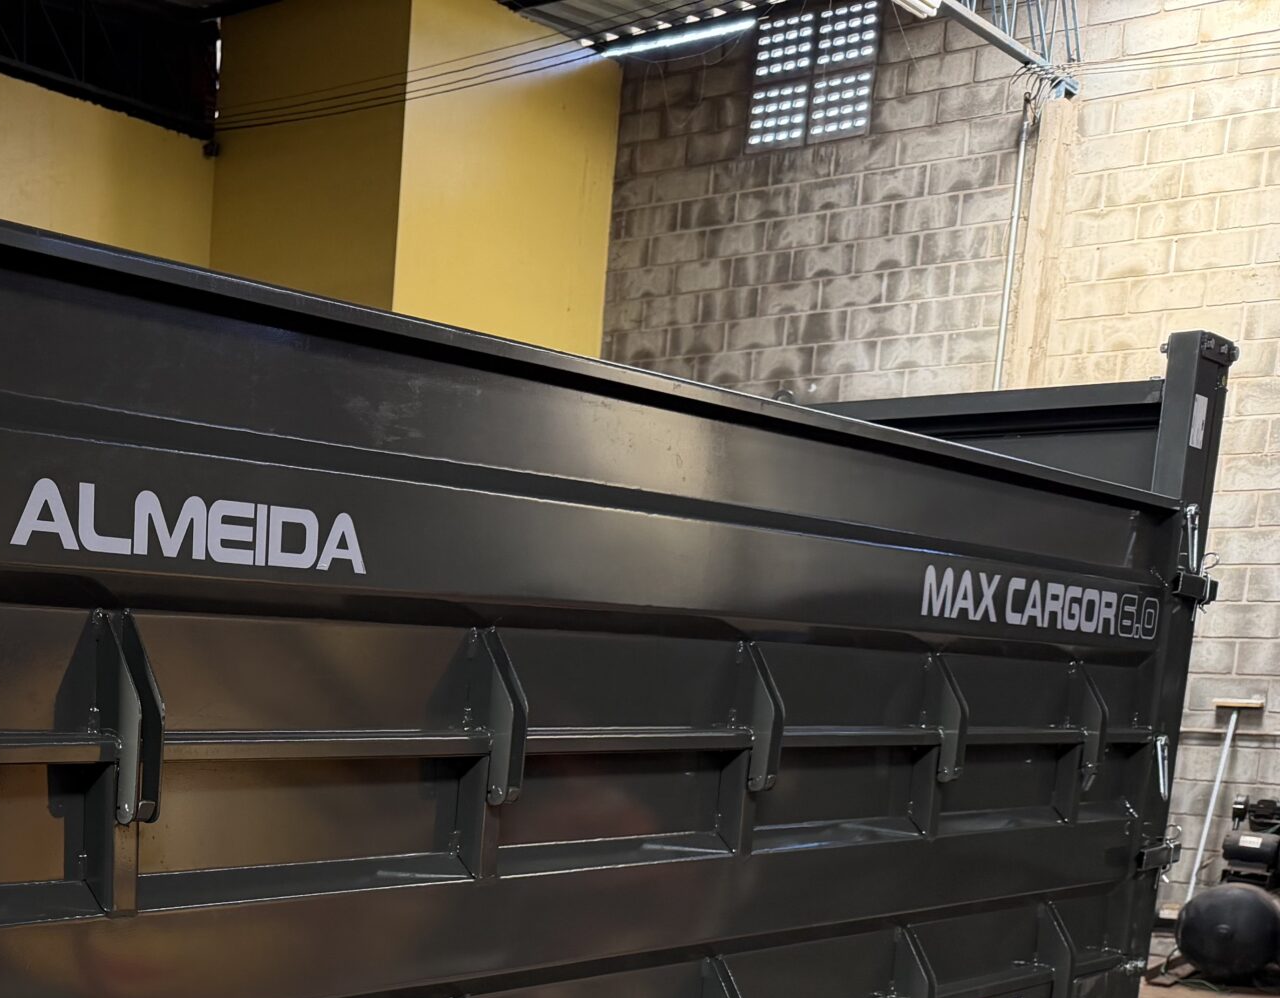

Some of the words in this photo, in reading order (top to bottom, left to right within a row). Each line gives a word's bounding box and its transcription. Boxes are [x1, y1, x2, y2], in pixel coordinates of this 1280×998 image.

[10, 477, 366, 574] ALMEIDA
[921, 564, 1002, 623] MAX
[1005, 577, 1118, 636] CARGOR
[1117, 593, 1160, 640] 6.0
